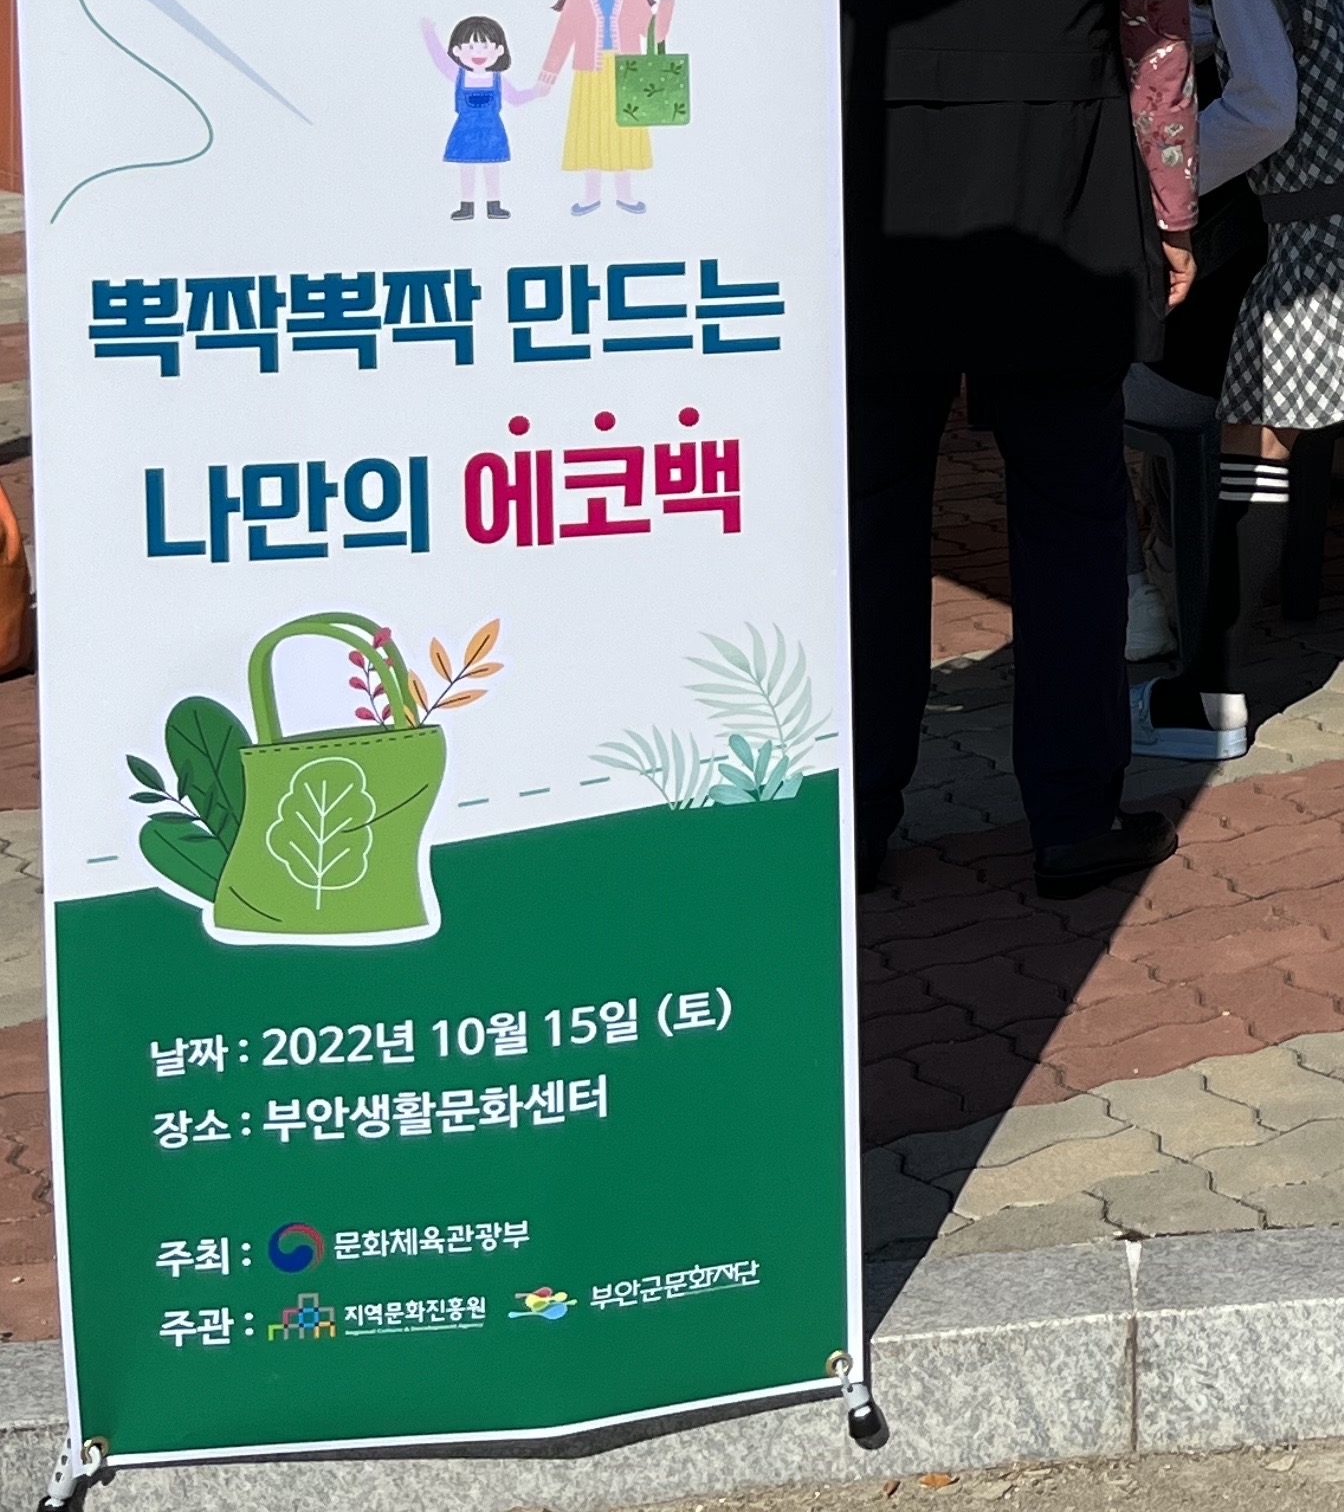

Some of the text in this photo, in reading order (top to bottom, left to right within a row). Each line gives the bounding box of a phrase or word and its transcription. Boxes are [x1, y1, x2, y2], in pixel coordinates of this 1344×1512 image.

[88, 258, 786, 377] 뽁짝뽁짝 만드는
[144, 438, 743, 563] 나만의 에코백
[150, 1034, 229, 1077] 날짜
[262, 1018, 416, 1066] 2022년
[432, 1010, 529, 1059] 10월
[544, 996, 640, 1049] 15일
[655, 986, 734, 1039] (토)
[153, 1110, 233, 1150] 장소
[263, 1073, 610, 1144] 부안생활문화센터
[155, 1236, 231, 1278] 주최
[333, 1219, 531, 1262] 문화체육관광부
[159, 1307, 235, 1348] 주관
[344, 1295, 487, 1325] 지역문화진흥원
[589, 1259, 761, 1310] 부안군문화재단
